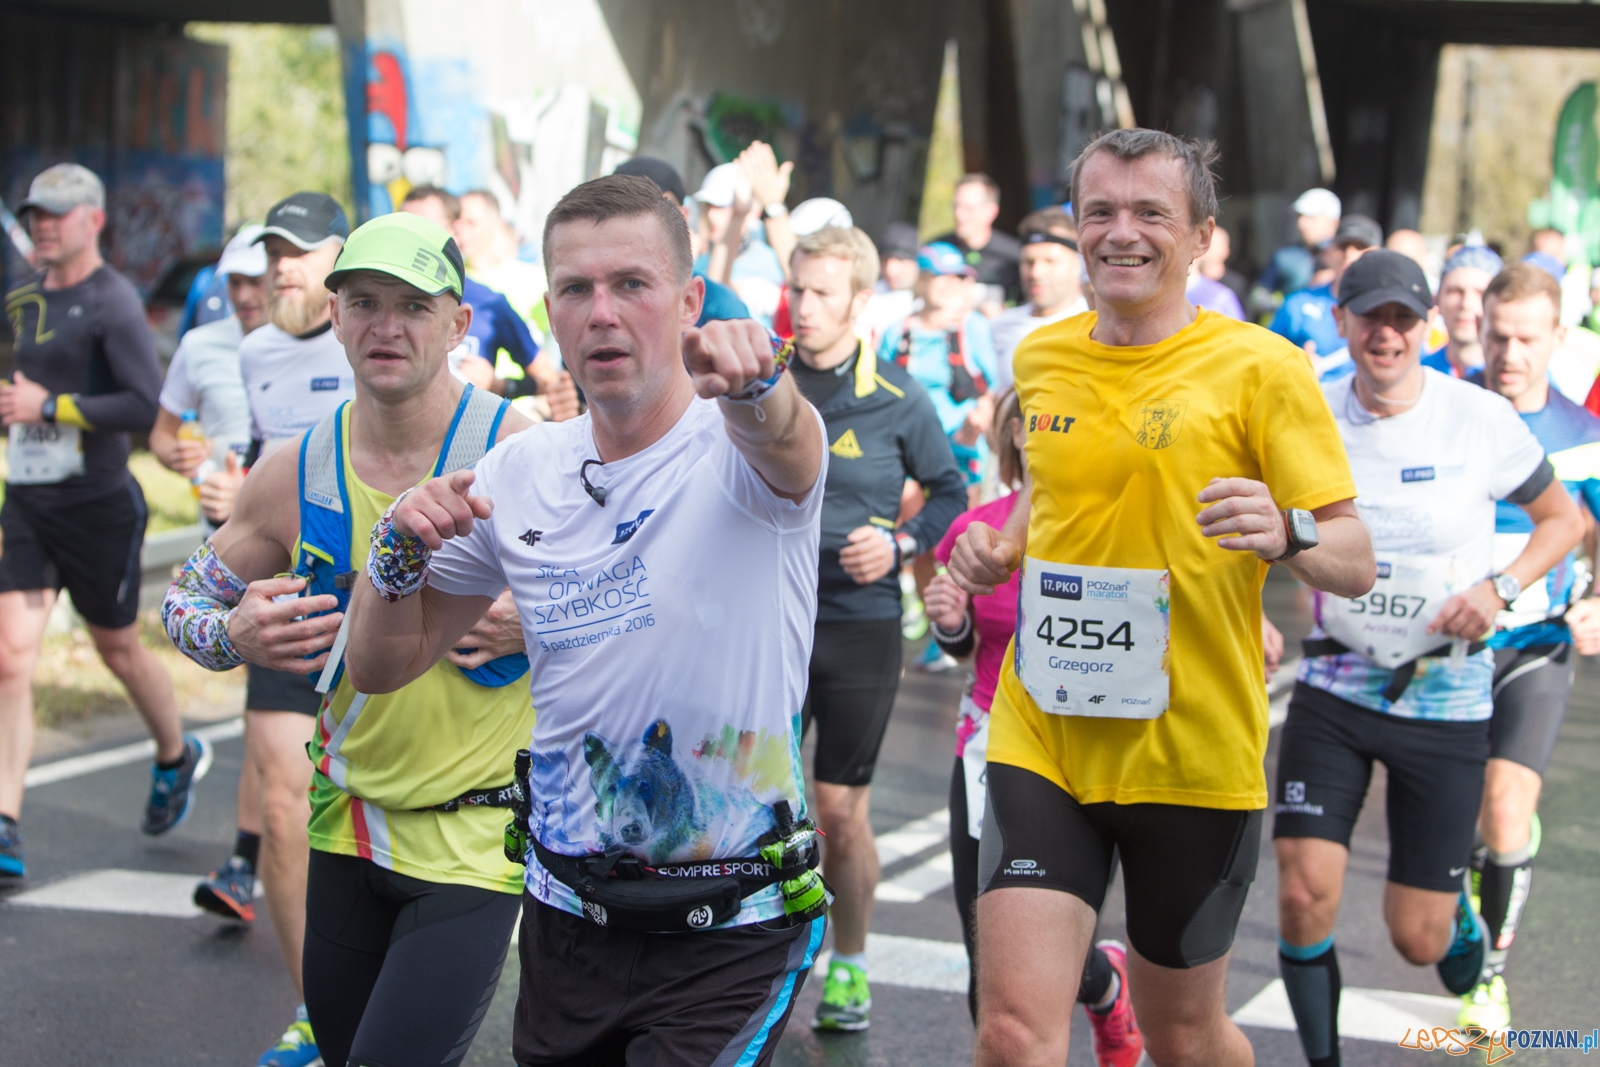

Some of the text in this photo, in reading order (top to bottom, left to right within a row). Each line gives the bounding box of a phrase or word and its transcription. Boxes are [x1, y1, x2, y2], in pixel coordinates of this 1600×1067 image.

[1029, 413, 1076, 434] BOLT
[1043, 578, 1079, 594] 17.PKO
[1087, 589, 1128, 599] maraton
[534, 574, 650, 625] SZYBKOŚĆ
[1348, 592, 1427, 619] 5967
[540, 613, 656, 653] 9 października 2016
[1036, 614, 1135, 651] 4254
[1048, 655, 1114, 675] Grzegorz
[692, 910, 708, 925] PZU
